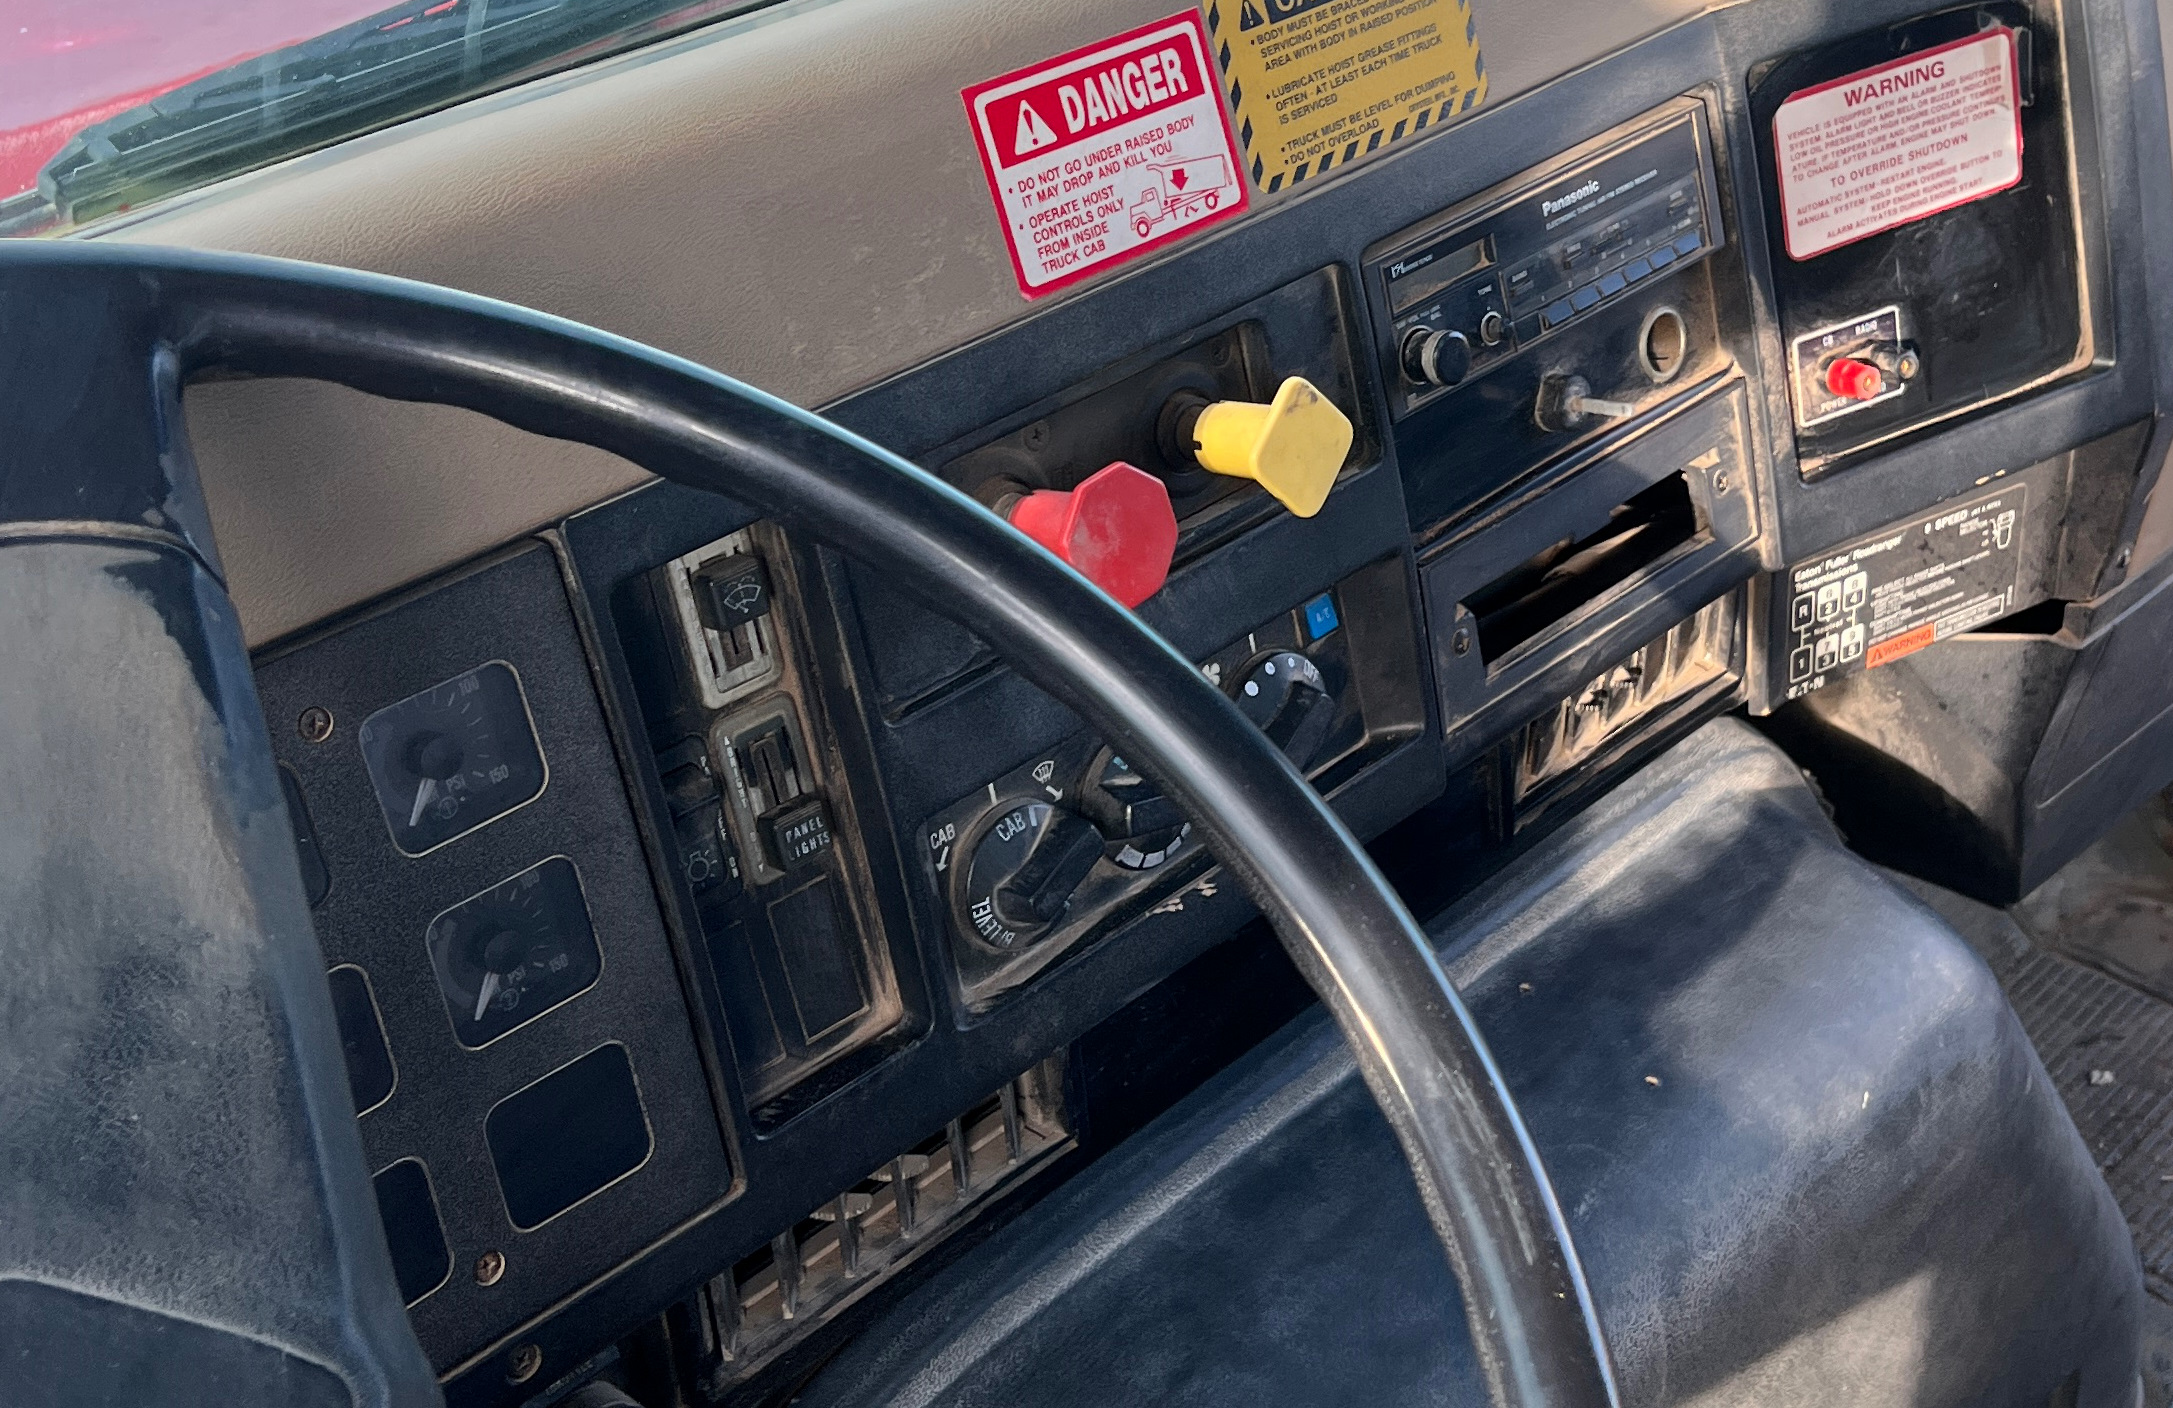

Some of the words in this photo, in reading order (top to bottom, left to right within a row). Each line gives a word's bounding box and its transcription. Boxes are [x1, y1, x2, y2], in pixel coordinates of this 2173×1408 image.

[1256, 26, 1284, 45] BODY
[1285, 14, 1314, 33] MUST
[1315, 8, 1329, 22] BE
[1260, 29, 1312, 58] SERVICING
[1313, 18, 1342, 37] HOIST
[1344, 11, 1359, 25] OR
[1264, 53, 1291, 72] AREA
[1293, 42, 1317, 60] WITH
[1318, 31, 1345, 50] BODY
[1347, 26, 1358, 38] IN
[1359, 12, 1393, 33] RAISED
[1271, 68, 1326, 98] LUBRICATE
[1326, 55, 1356, 75] HOIST
[1356, 39, 1396, 63] GREASE
[1397, 22, 1437, 46] FITTINGS
[1275, 90, 1308, 112] OFTEN
[1314, 82, 1328, 95] AT
[1328, 68, 1360, 89] LEAST
[1360, 57, 1387, 75] EACH
[1388, 47, 1410, 64] TIME
[1411, 34, 1442, 54] TRUCK
[1056, 45, 1189, 134] DANGER
[1787, 123, 1819, 141] VEHICLE
[1823, 119, 1831, 129] IS
[1834, 106, 1872, 125] EQUIPPED
[1875, 98, 1894, 112] WITH
[1897, 93, 1908, 104] AN
[1911, 84, 1936, 100] ALARM
[1940, 78, 1955, 90] AND
[1959, 63, 2001, 83] SHUTDOWN
[1844, 60, 1945, 108] WARNING
[1279, 113, 1289, 125] IS
[1290, 92, 1338, 120] SERVICED
[1286, 129, 1319, 151] TRUCK
[1320, 117, 1348, 137] MUST
[1348, 111, 1362, 124] BE
[1363, 97, 1393, 118] LEVEL
[1393, 88, 1413, 104] FOR
[1414, 70, 1455, 95] DUMPING
[1825, 123, 1851, 140] ALARM
[1854, 114, 1876, 130] LIGHT
[1878, 108, 1894, 122] AND
[1896, 101, 1915, 116] BELL
[1917, 97, 1928, 109] OR
[1930, 86, 1959, 104] BUZZER
[1962, 73, 2001, 92] INDICATES
[1290, 150, 1306, 164] DO
[1306, 141, 1326, 157] NOT
[1327, 117, 1379, 148] OVERLOAD
[1790, 148, 1807, 162] LOW
[1809, 143, 1822, 155] OIL
[1824, 130, 1865, 149] PRESSURE
[1867, 124, 1878, 136] OR
[1880, 117, 1898, 131] HIGH
[1901, 107, 1928, 124] ENGINE
[1930, 95, 1965, 114] COOLANT
[1821, 153, 1827, 162] IF
[1831, 134, 1886, 158] TEMPERATURE
[1922, 108, 1960, 128] PRESSURE
[1962, 94, 2004, 113] CONTINUES
[1017, 175, 1035, 193] DO
[1037, 166, 1061, 185] NOT
[1063, 158, 1082, 175] GO
[1084, 142, 1122, 167] UNDER
[1124, 126, 1164, 151] RAISED
[1166, 114, 1196, 135] BODY
[1792, 172, 1803, 183] TO
[1806, 160, 1838, 178] CHANGE
[1842, 150, 1867, 166] AFTER
[1900, 129, 1928, 146] ENGINE
[1930, 122, 1947, 135] MAY
[1950, 115, 1968, 129] SHUT
[1830, 173, 1845, 189] TO
[1849, 154, 1903, 181] OVERRIDE
[1907, 132, 1968, 161] SHUTDOWN
[1021, 194, 1034, 208] IT
[1036, 183, 1060, 202] MAY
[1062, 170, 1094, 192] DROP
[1096, 160, 1121, 179] AND
[1123, 150, 1147, 168] KILL
[1149, 140, 1172, 158] YOU
[1028, 199, 1080, 229] OPERATE
[1081, 184, 1116, 207] HOIST
[1541, 179, 1600, 217] Panasonic
[1796, 194, 1842, 215] AUTOMATIC
[1032, 210, 1094, 244] CONTROLS
[1096, 197, 1125, 218] ONLY
[1037, 236, 1070, 259] FROM
[1072, 221, 1109, 245] INSIDE
[1041, 249, 1080, 274] TRUCK
[1082, 239, 1106, 257] CAB
[1934, 509, 1968, 530] SPEED
[1798, 603, 1808, 619] R
[1824, 600, 1833, 615] 2
[1849, 590, 1858, 605] 4
[1822, 652, 1830, 667] 3
[1824, 640, 1830, 652] 7
[1882, 628, 1931, 656] WARNING
[1798, 656, 1804, 670] 1
[458, 675, 480, 696] 100
[446, 773, 467, 792] PSI
[489, 763, 510, 785] 150
[785, 816, 824, 843] PANEL
[930, 823, 956, 850] CAB
[996, 812, 1026, 841] CAB
[788, 831, 830, 861] LIGHTS
[972, 896, 1003, 941] LEVEL
[508, 965, 527, 984] PSI
[549, 953, 569, 974] 150
